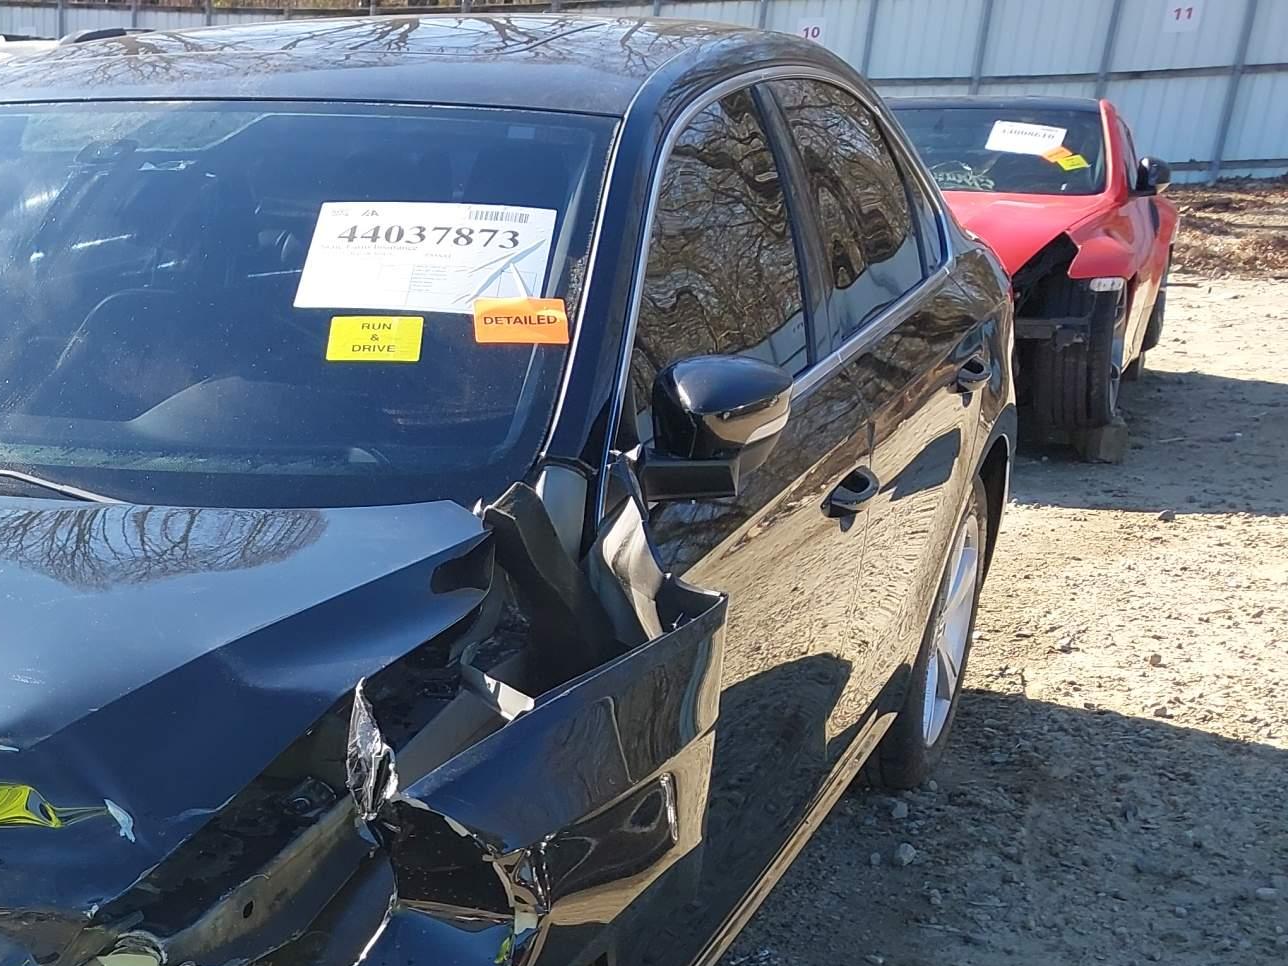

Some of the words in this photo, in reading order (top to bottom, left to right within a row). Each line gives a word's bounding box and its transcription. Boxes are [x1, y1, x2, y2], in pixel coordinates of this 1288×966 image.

[1172, 6, 1195, 21] 11
[801, 25, 822, 39] 10
[337, 224, 520, 250] 44037873
[482, 315, 557, 326] DETAILED
[361, 322, 393, 331] RUN
[369, 333, 380, 342] &
[351, 344, 396, 353] DRIVE
